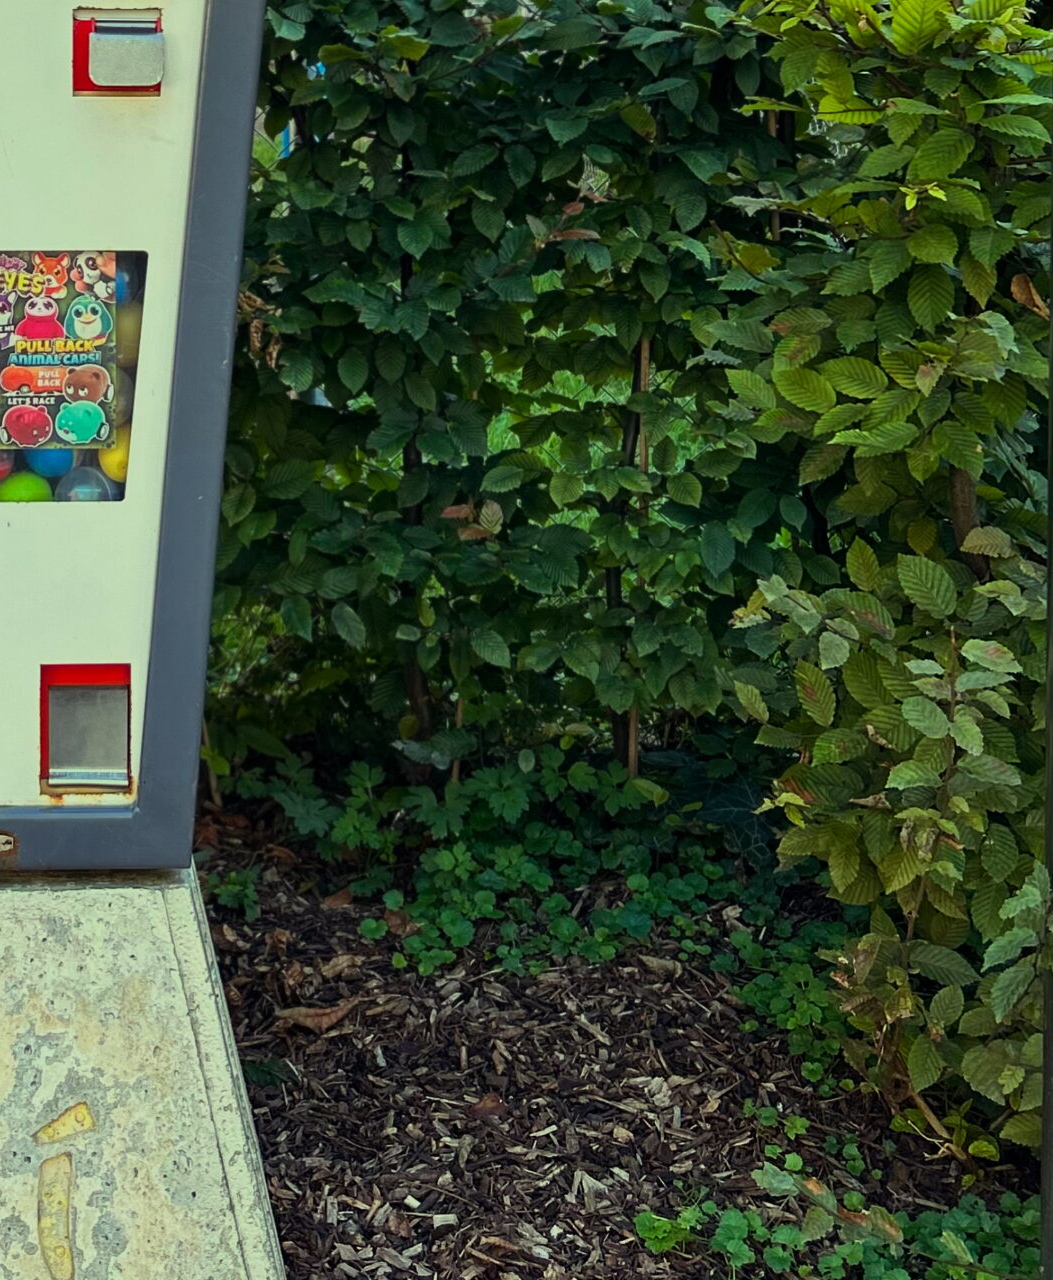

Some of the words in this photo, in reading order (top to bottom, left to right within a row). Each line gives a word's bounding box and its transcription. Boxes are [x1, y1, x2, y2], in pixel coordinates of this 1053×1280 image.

[17, 340, 51, 352] PULL
[55, 340, 93, 352] BACK
[9, 354, 60, 365] ANIMAL
[63, 353, 100, 364] CARS!
[8, 397, 30, 405] LET'S
